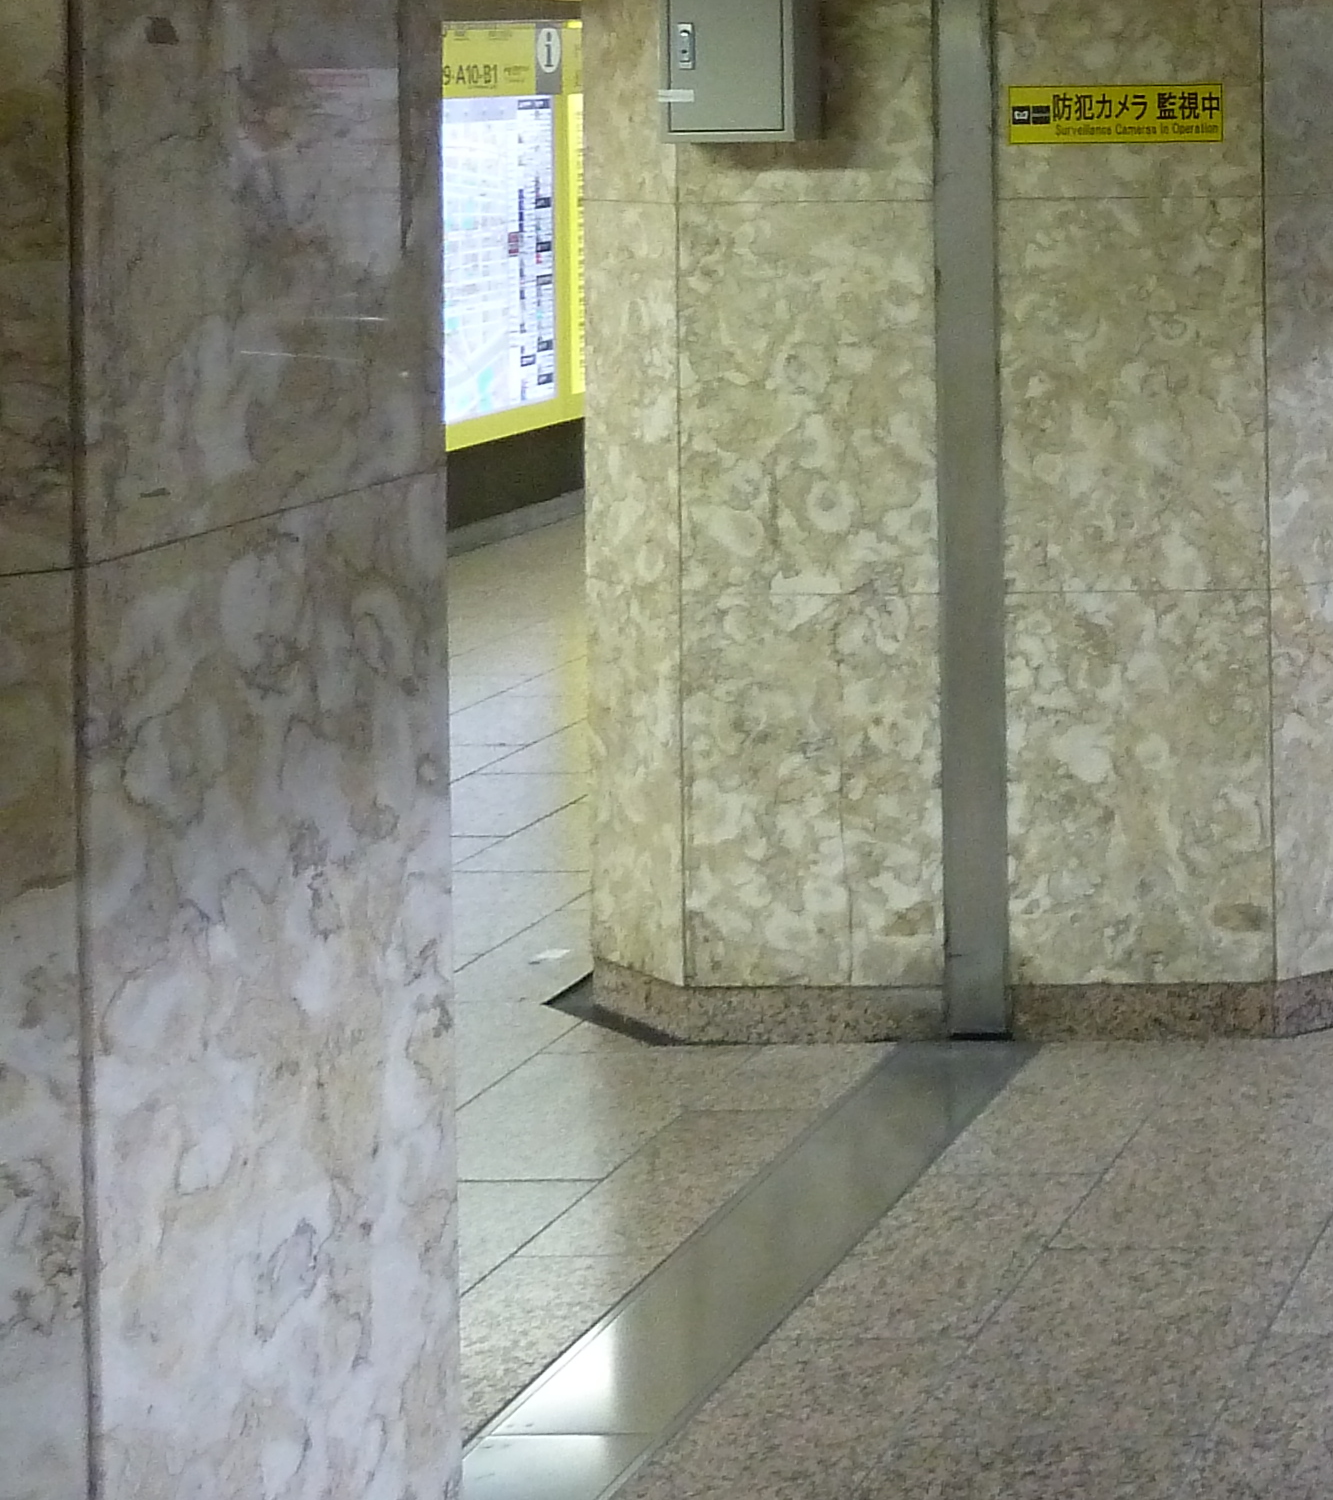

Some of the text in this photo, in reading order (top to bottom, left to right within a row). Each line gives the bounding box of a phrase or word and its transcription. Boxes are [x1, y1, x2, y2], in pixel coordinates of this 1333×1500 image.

[1052, 91, 1221, 122] 防犯カメラ 監視中
[1055, 124, 1112, 136] Surveillance
[1115, 124, 1157, 135] Cameras
[1172, 122, 1219, 135] Operation
